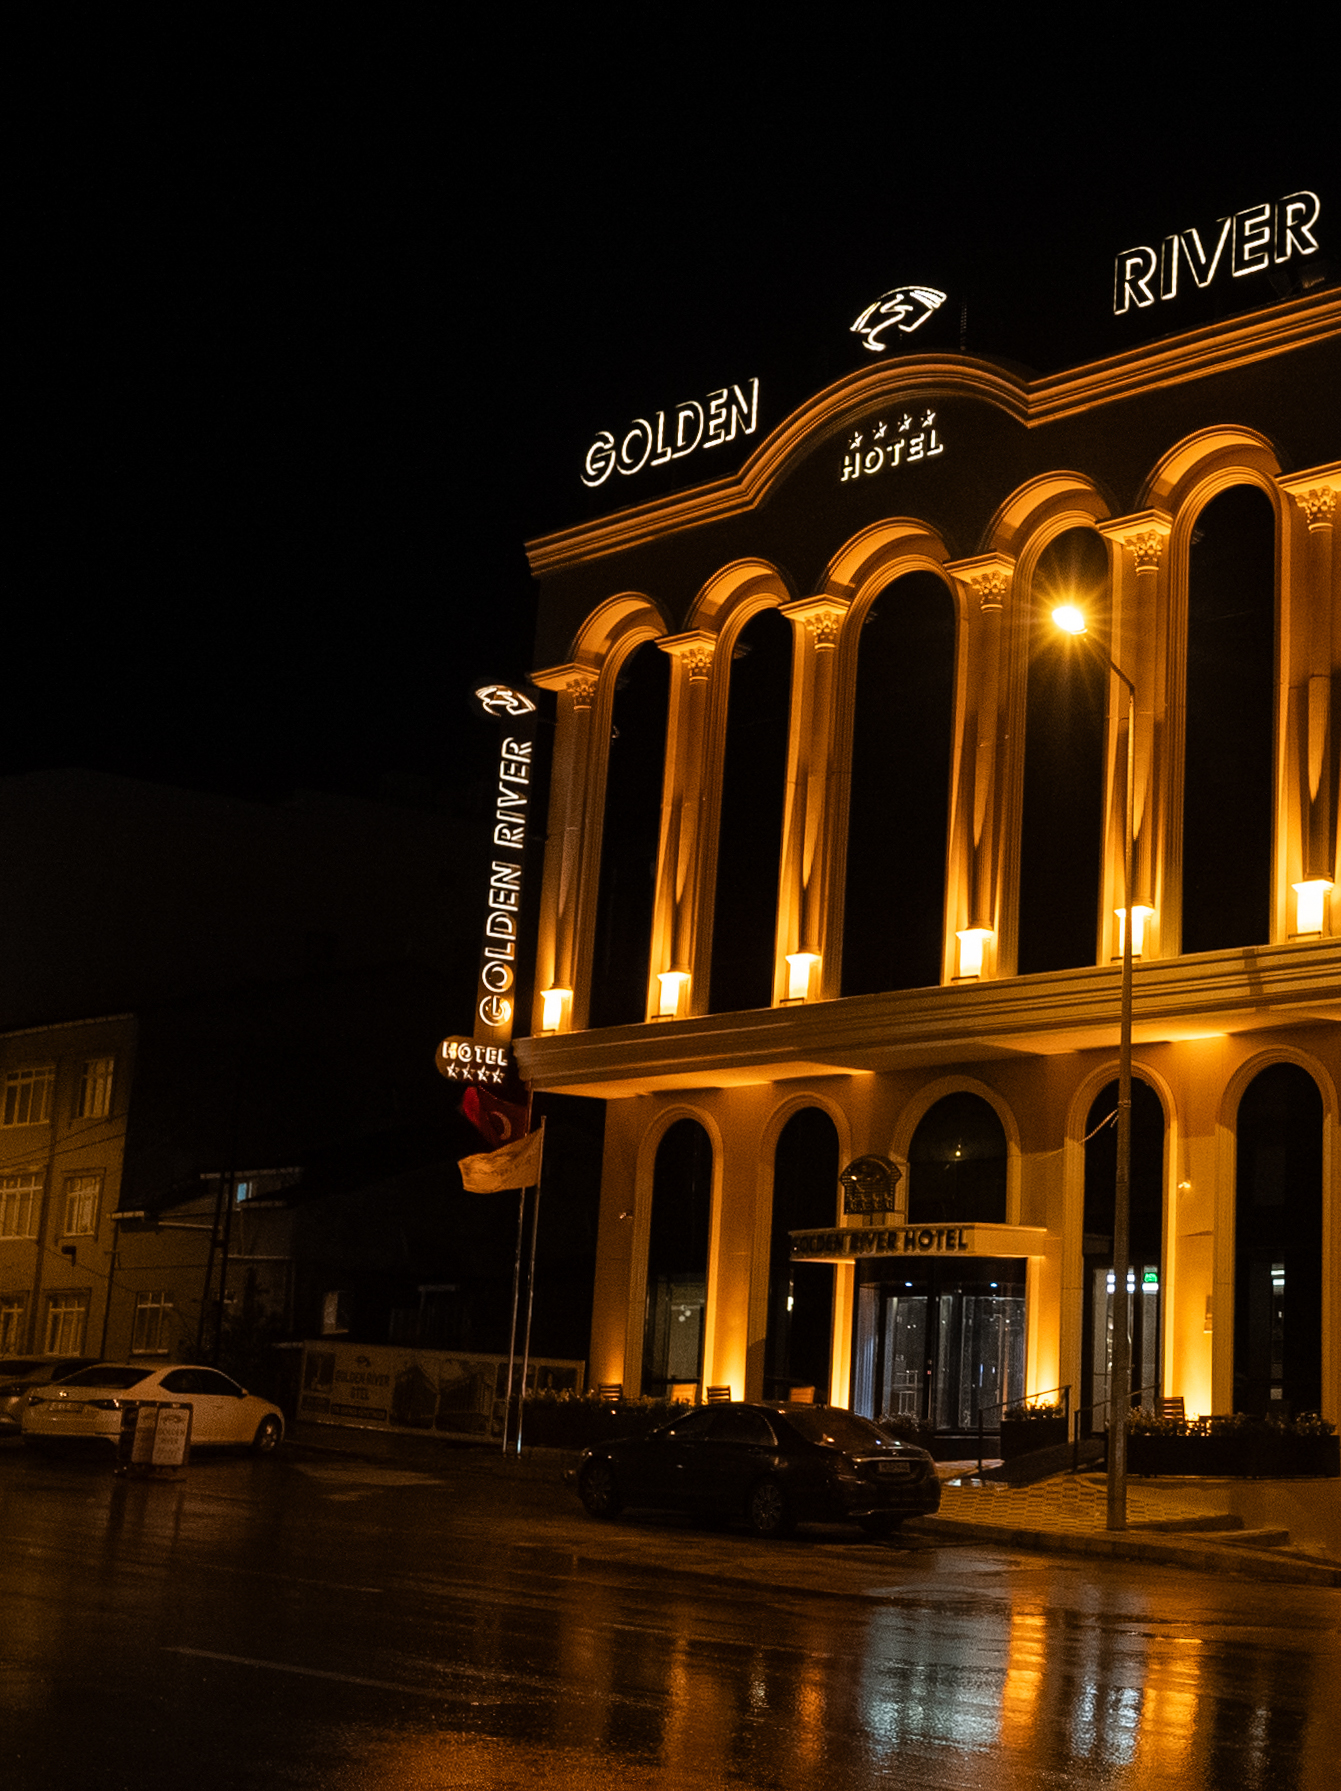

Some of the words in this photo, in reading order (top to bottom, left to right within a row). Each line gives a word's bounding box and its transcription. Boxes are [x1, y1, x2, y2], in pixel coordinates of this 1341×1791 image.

[580, 377, 760, 487] GOLDEN
[1113, 190, 1321, 315] RIVER
[840, 429, 944, 482] HOTEL
[494, 737, 532, 848] RIVER
[479, 860, 522, 1028] GOLDEN
[442, 1040, 508, 1066] HOTEL
[904, 1229, 968, 1250] HOTEL
